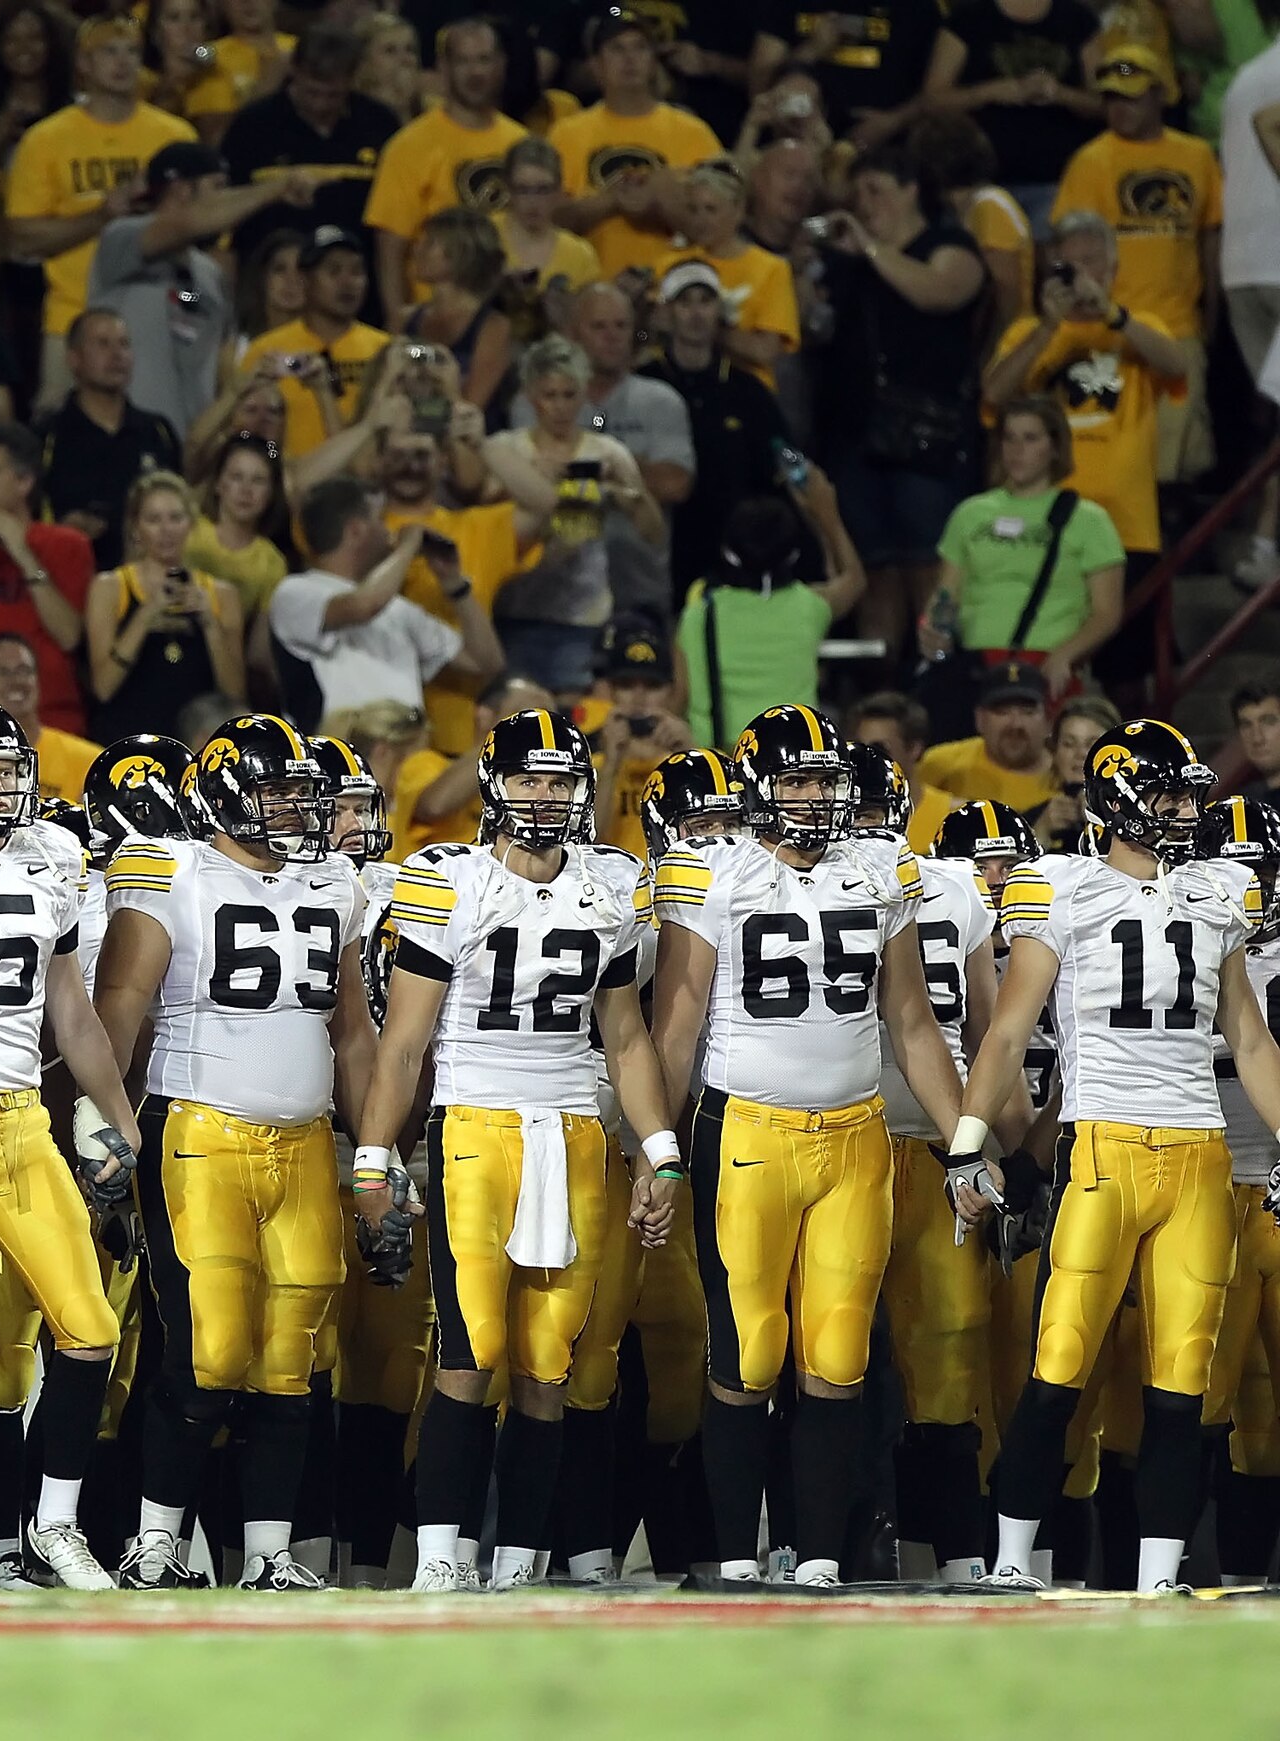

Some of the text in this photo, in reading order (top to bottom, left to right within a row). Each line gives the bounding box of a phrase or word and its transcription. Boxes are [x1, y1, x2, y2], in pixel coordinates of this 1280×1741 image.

[295, 761, 312, 769] IOWA
[715, 796, 734, 804] IOWA
[987, 838, 1006, 846] IOWA
[209, 903, 340, 1010] 63
[477, 927, 600, 1032] 12
[741, 909, 878, 1019] 65
[1109, 919, 1198, 1029] 11
